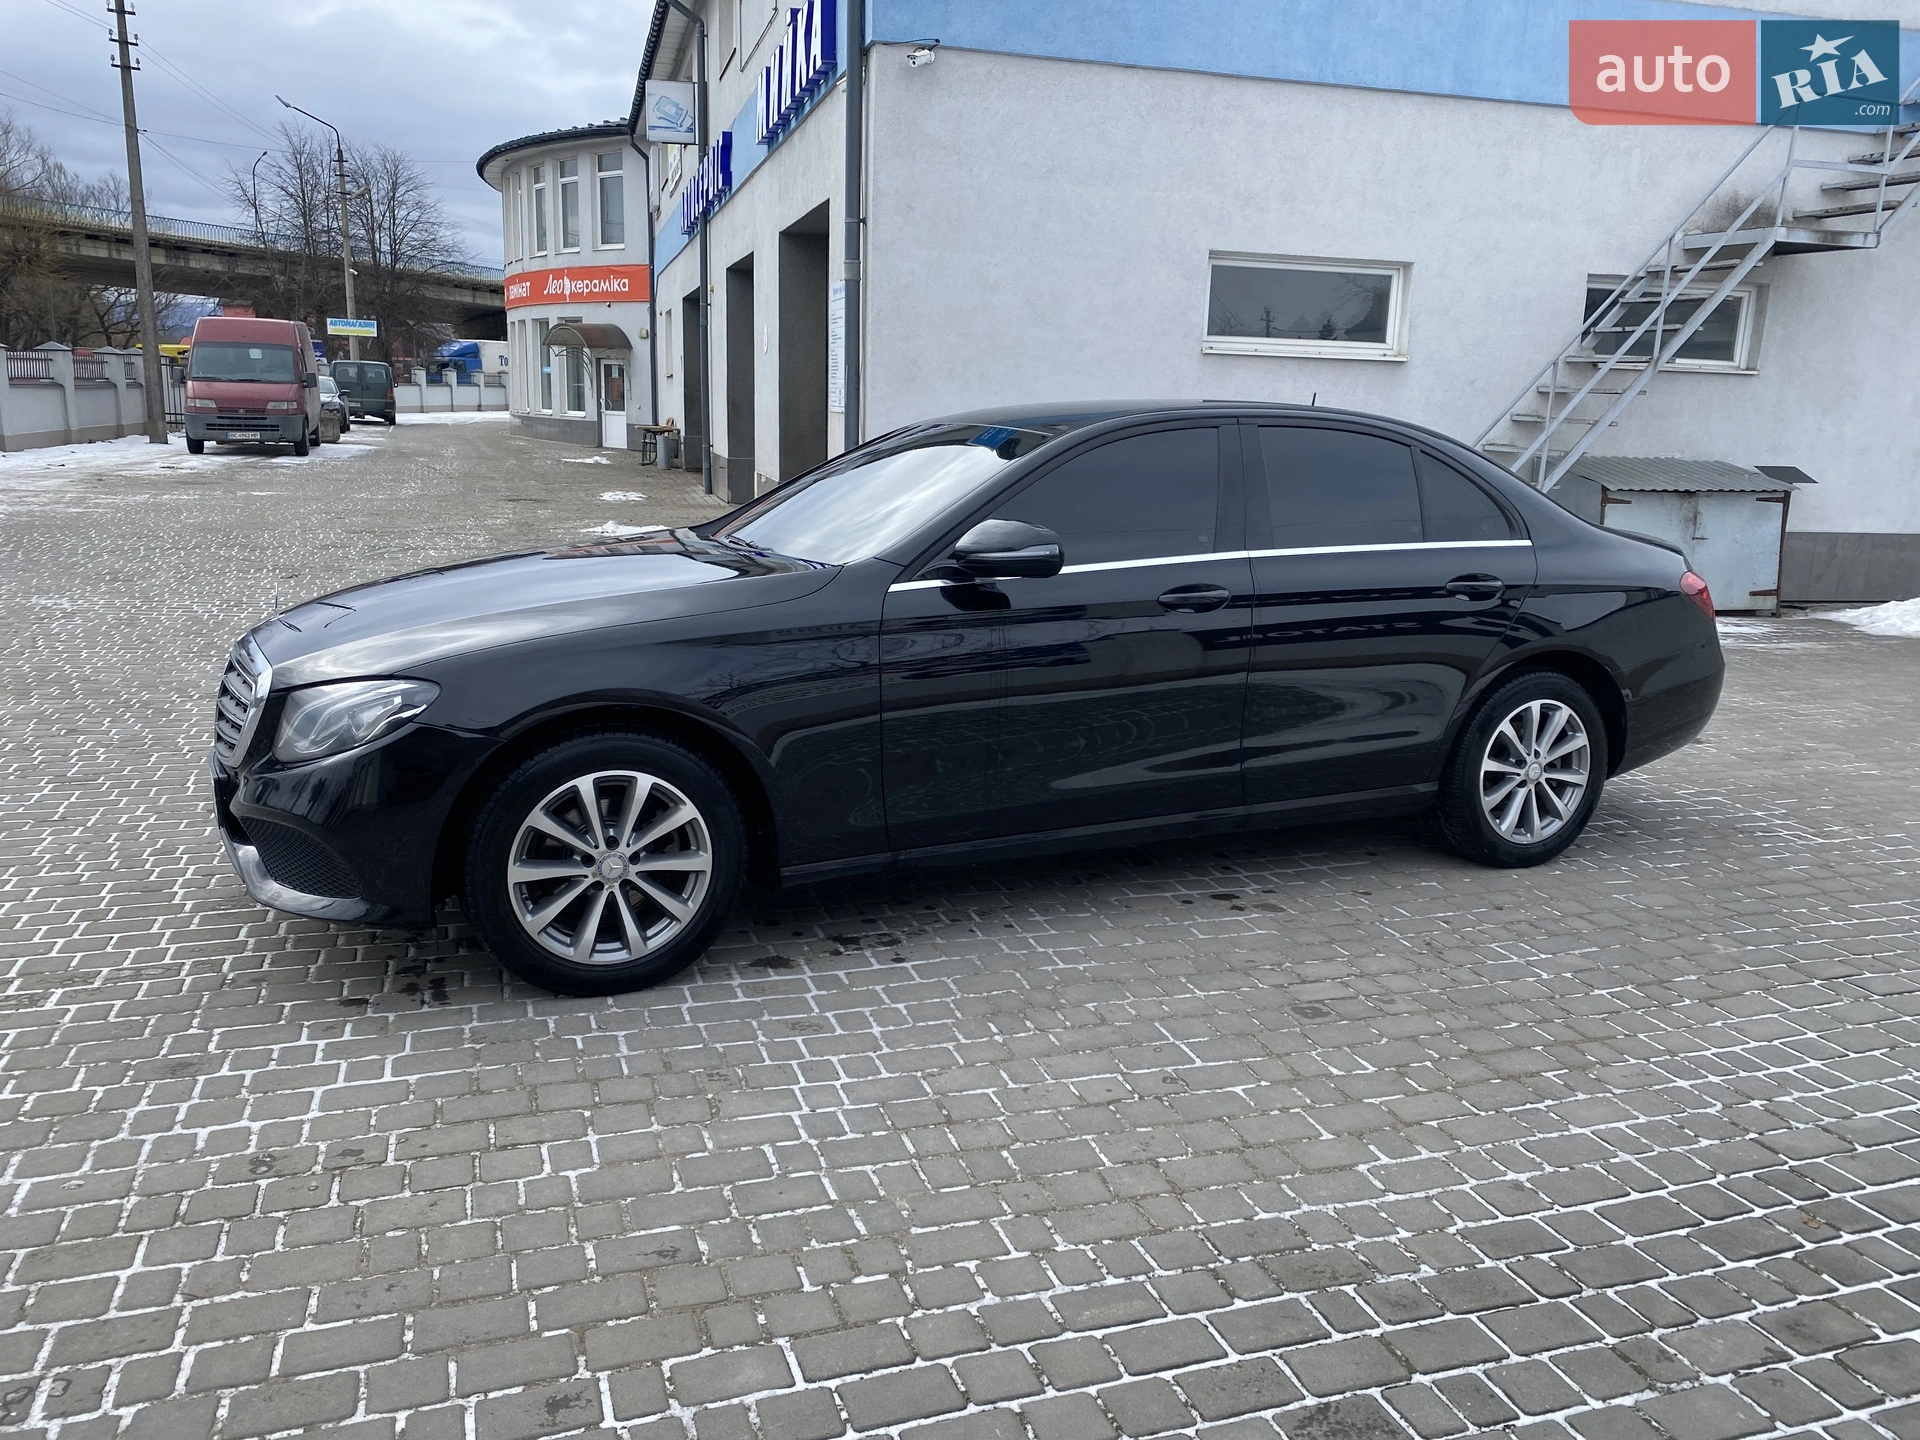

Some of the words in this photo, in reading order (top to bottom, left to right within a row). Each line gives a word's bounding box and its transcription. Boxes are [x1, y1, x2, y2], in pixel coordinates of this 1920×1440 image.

[756, 0, 832, 144] МИЙКА
[543, 273, 563, 295] Лео
[571, 274, 629, 296] кераміка
[329, 319, 376, 329] АВТОМАГАЗИН
